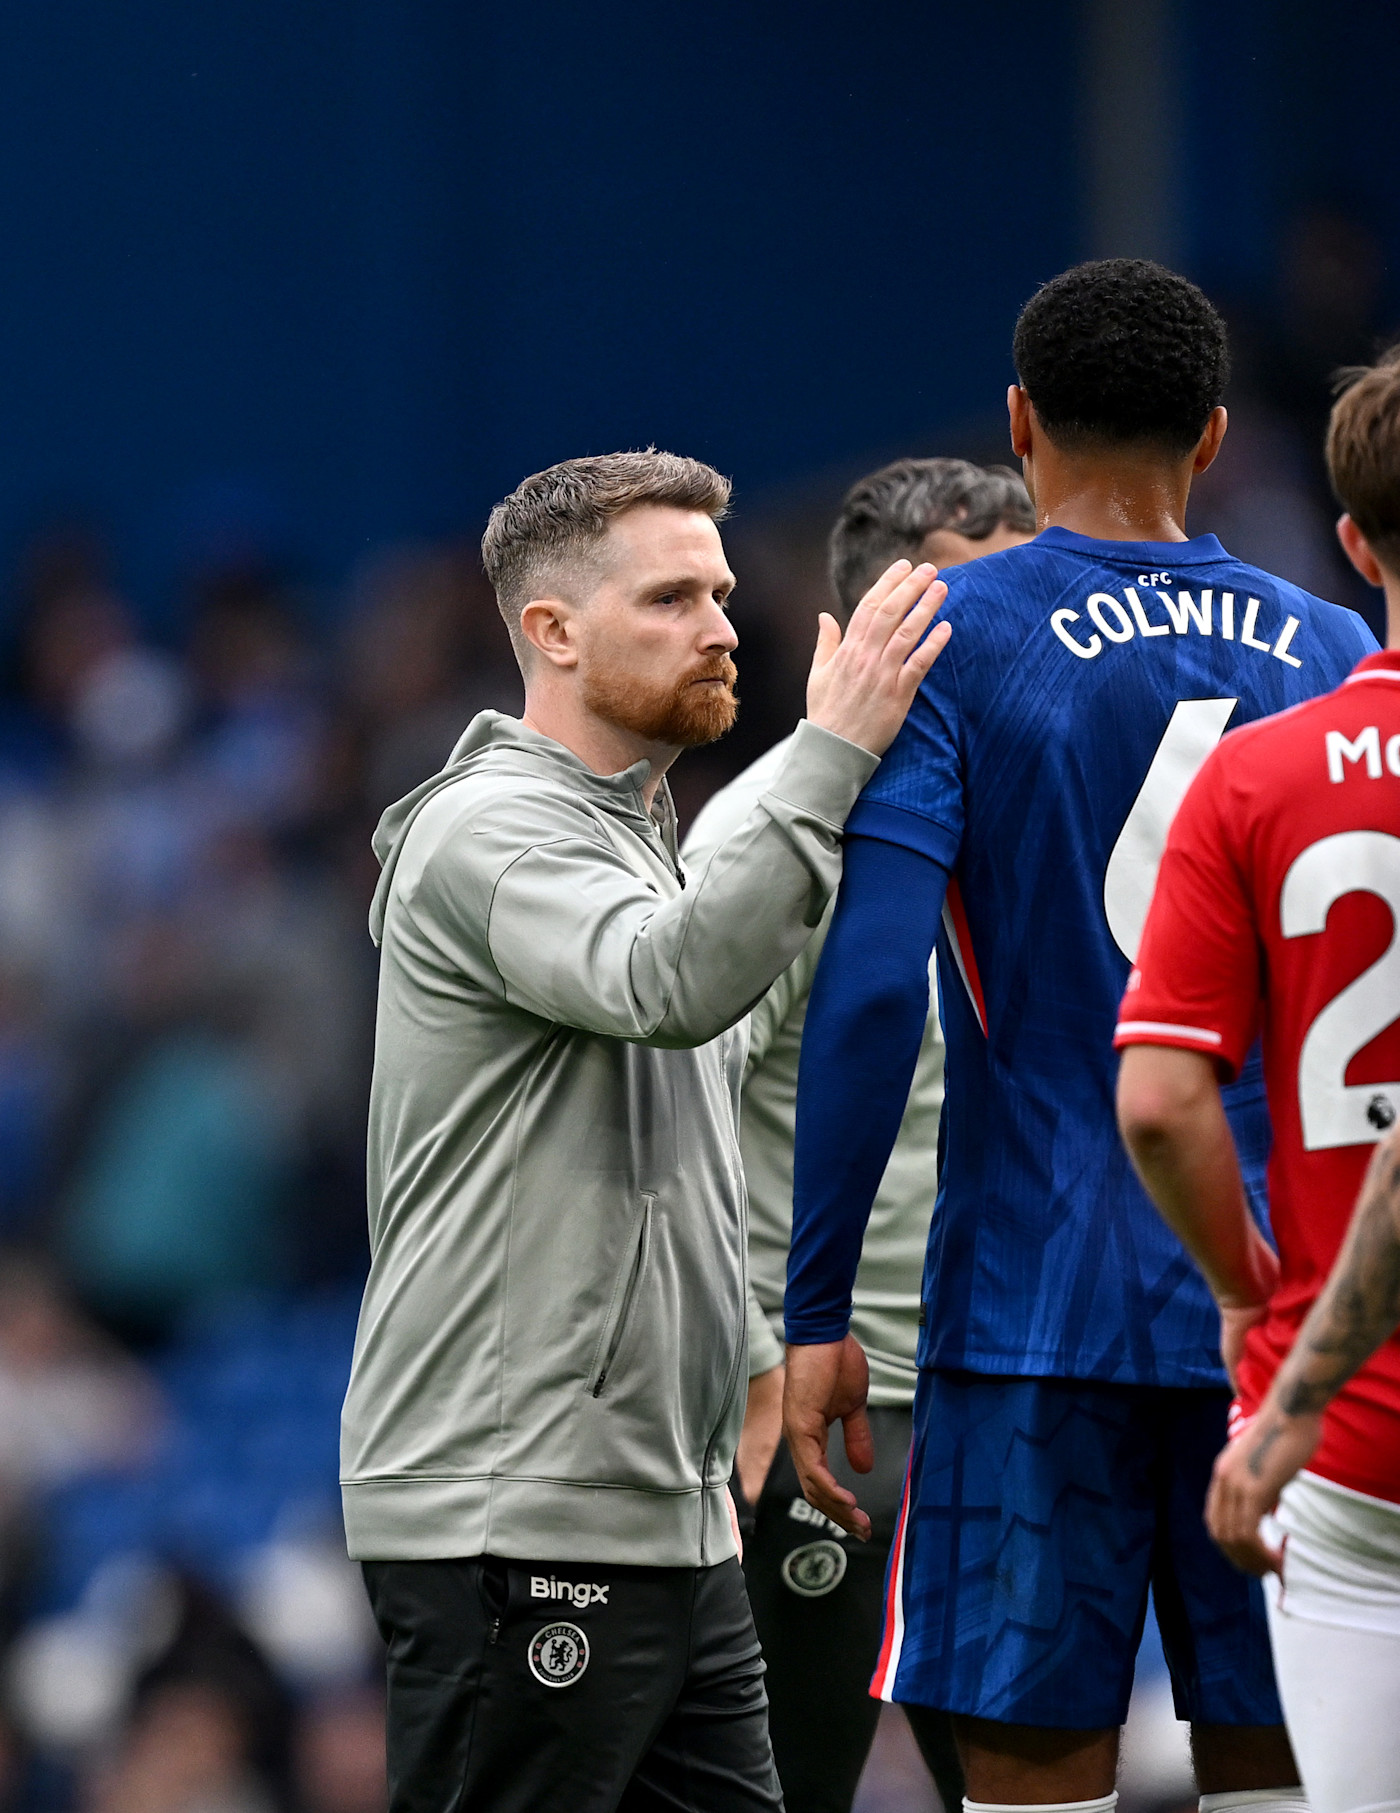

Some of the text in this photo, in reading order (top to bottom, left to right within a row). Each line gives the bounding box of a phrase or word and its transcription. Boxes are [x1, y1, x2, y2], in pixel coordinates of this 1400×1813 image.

[1138, 572, 1172, 587] CFC
[1050, 587, 1302, 668] COLWILL
[545, 1627, 580, 1643] CHELSEA
